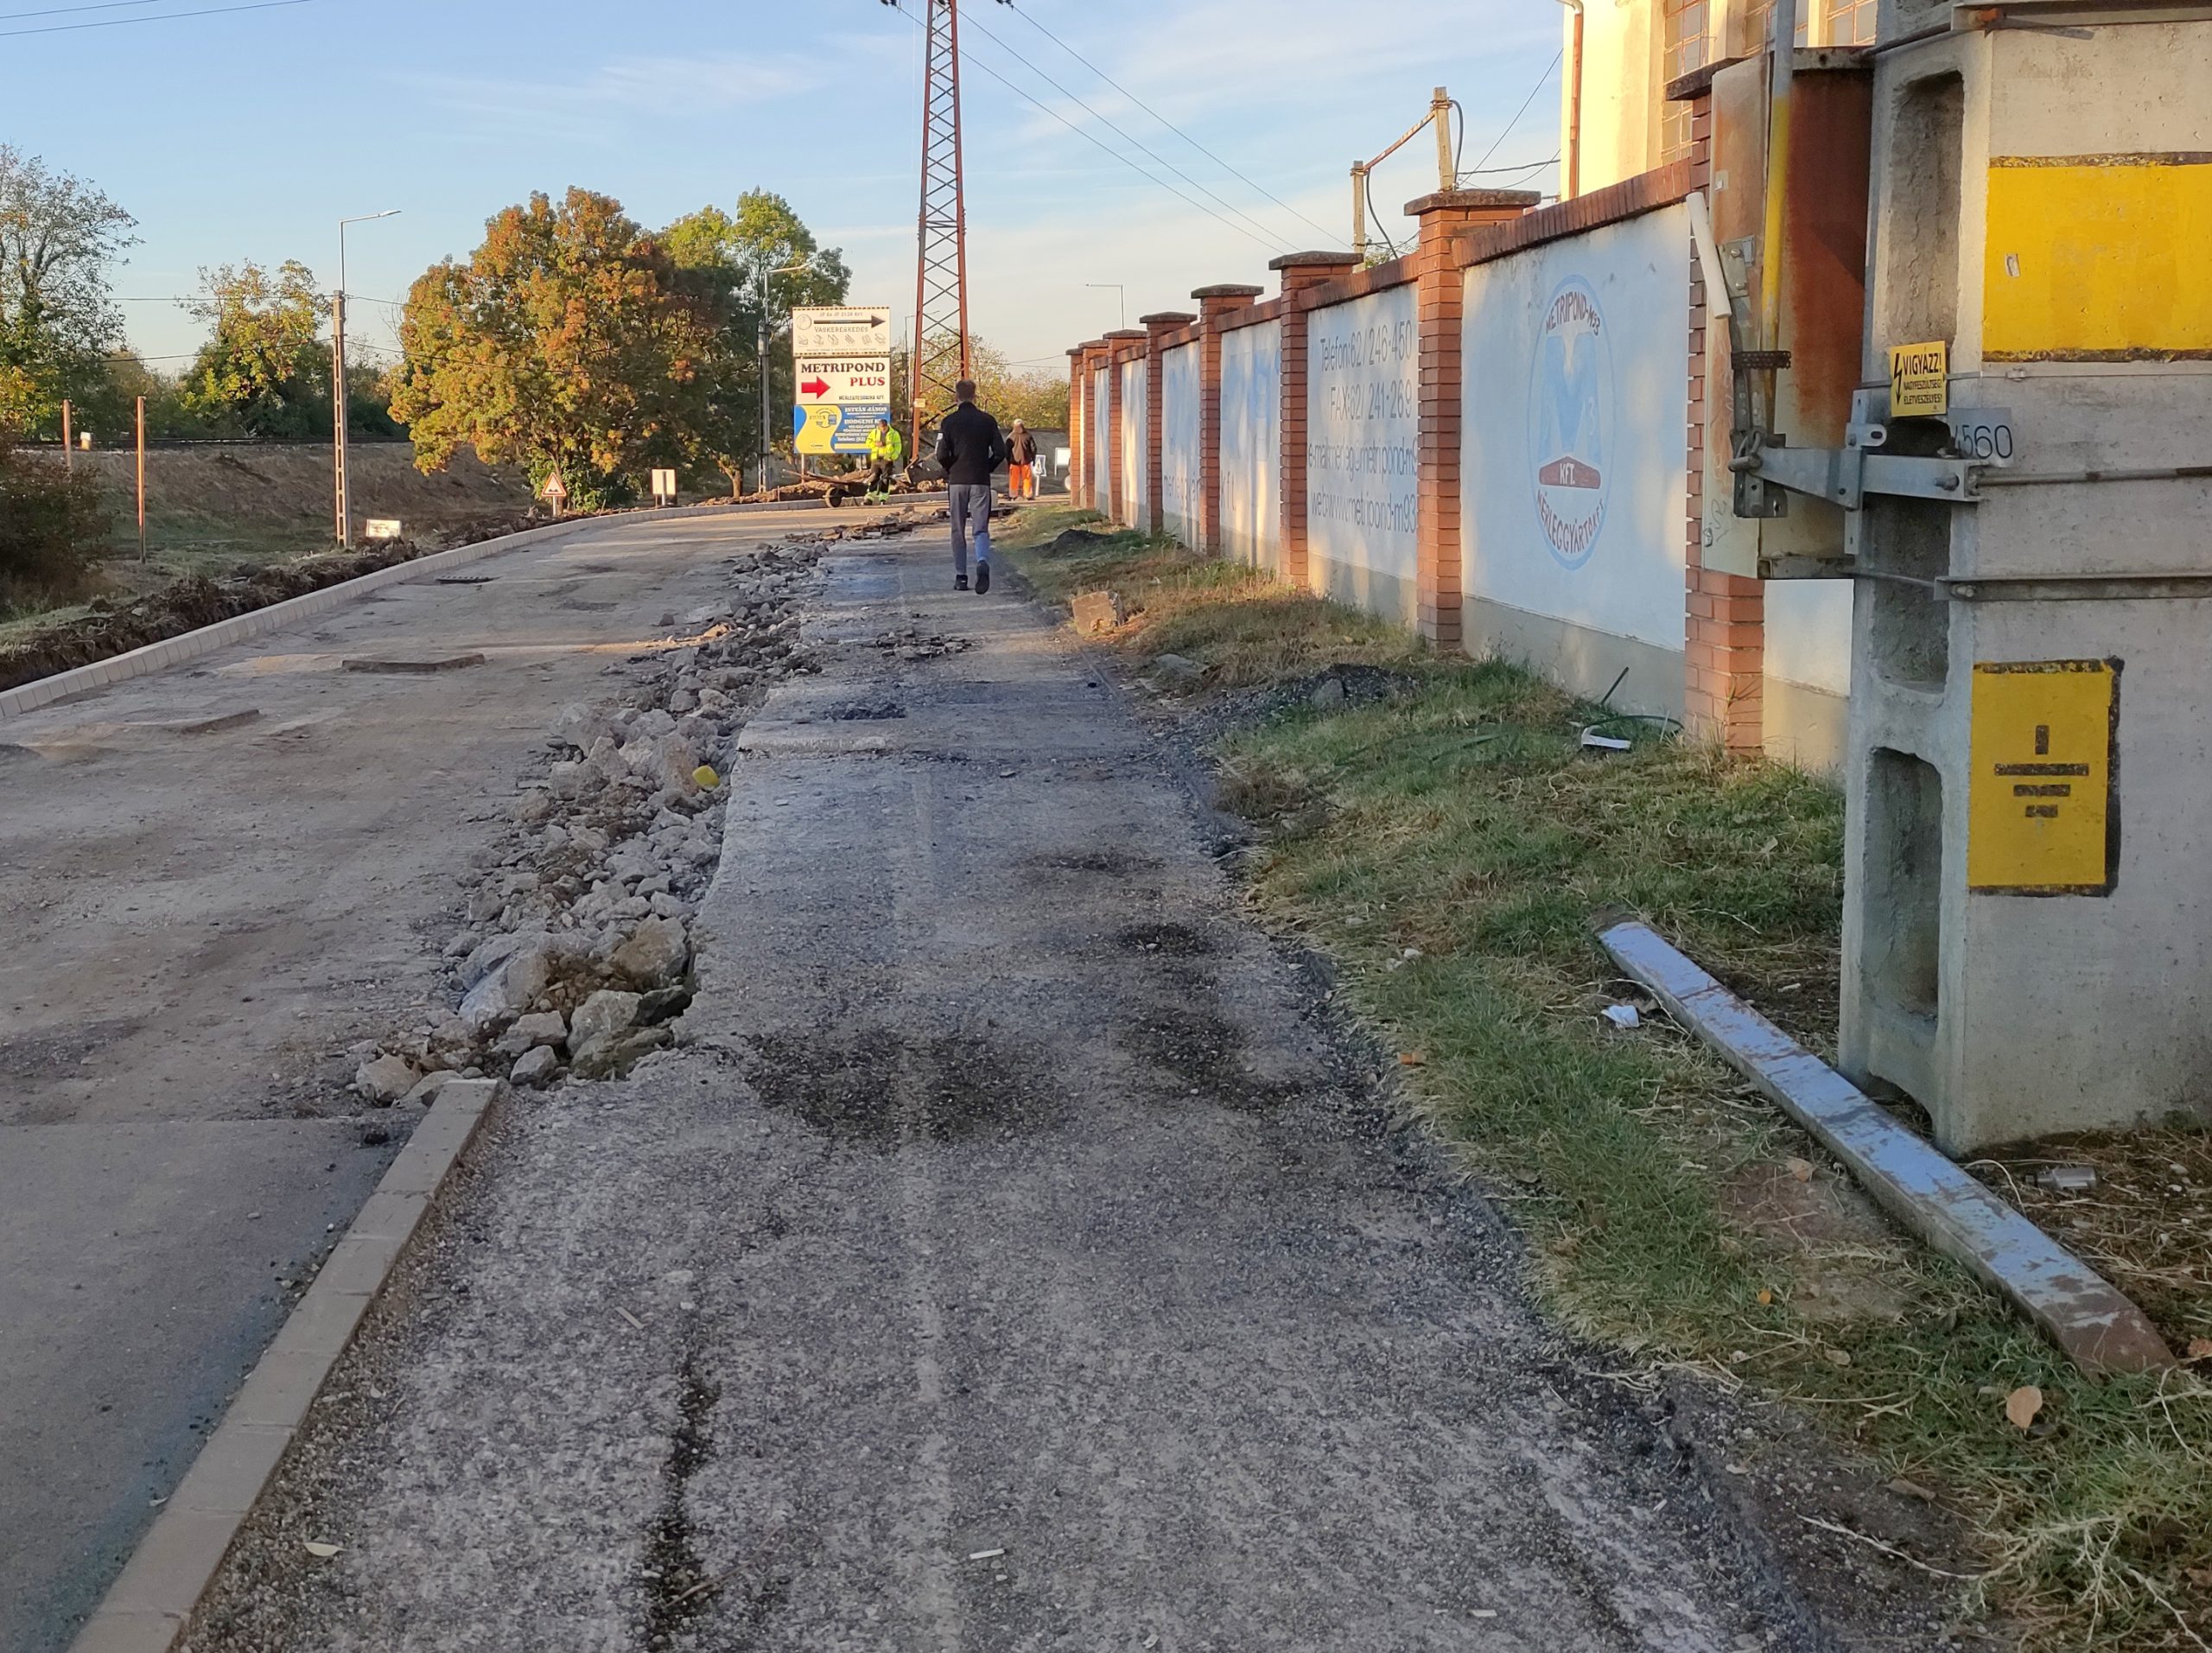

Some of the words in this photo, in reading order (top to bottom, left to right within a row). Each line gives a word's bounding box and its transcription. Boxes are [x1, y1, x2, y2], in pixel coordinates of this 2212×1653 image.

[801, 362, 886, 373] METRIPOND
[1903, 348, 1942, 376] VIGYÁZZ!
[849, 377, 886, 386] PLUS
